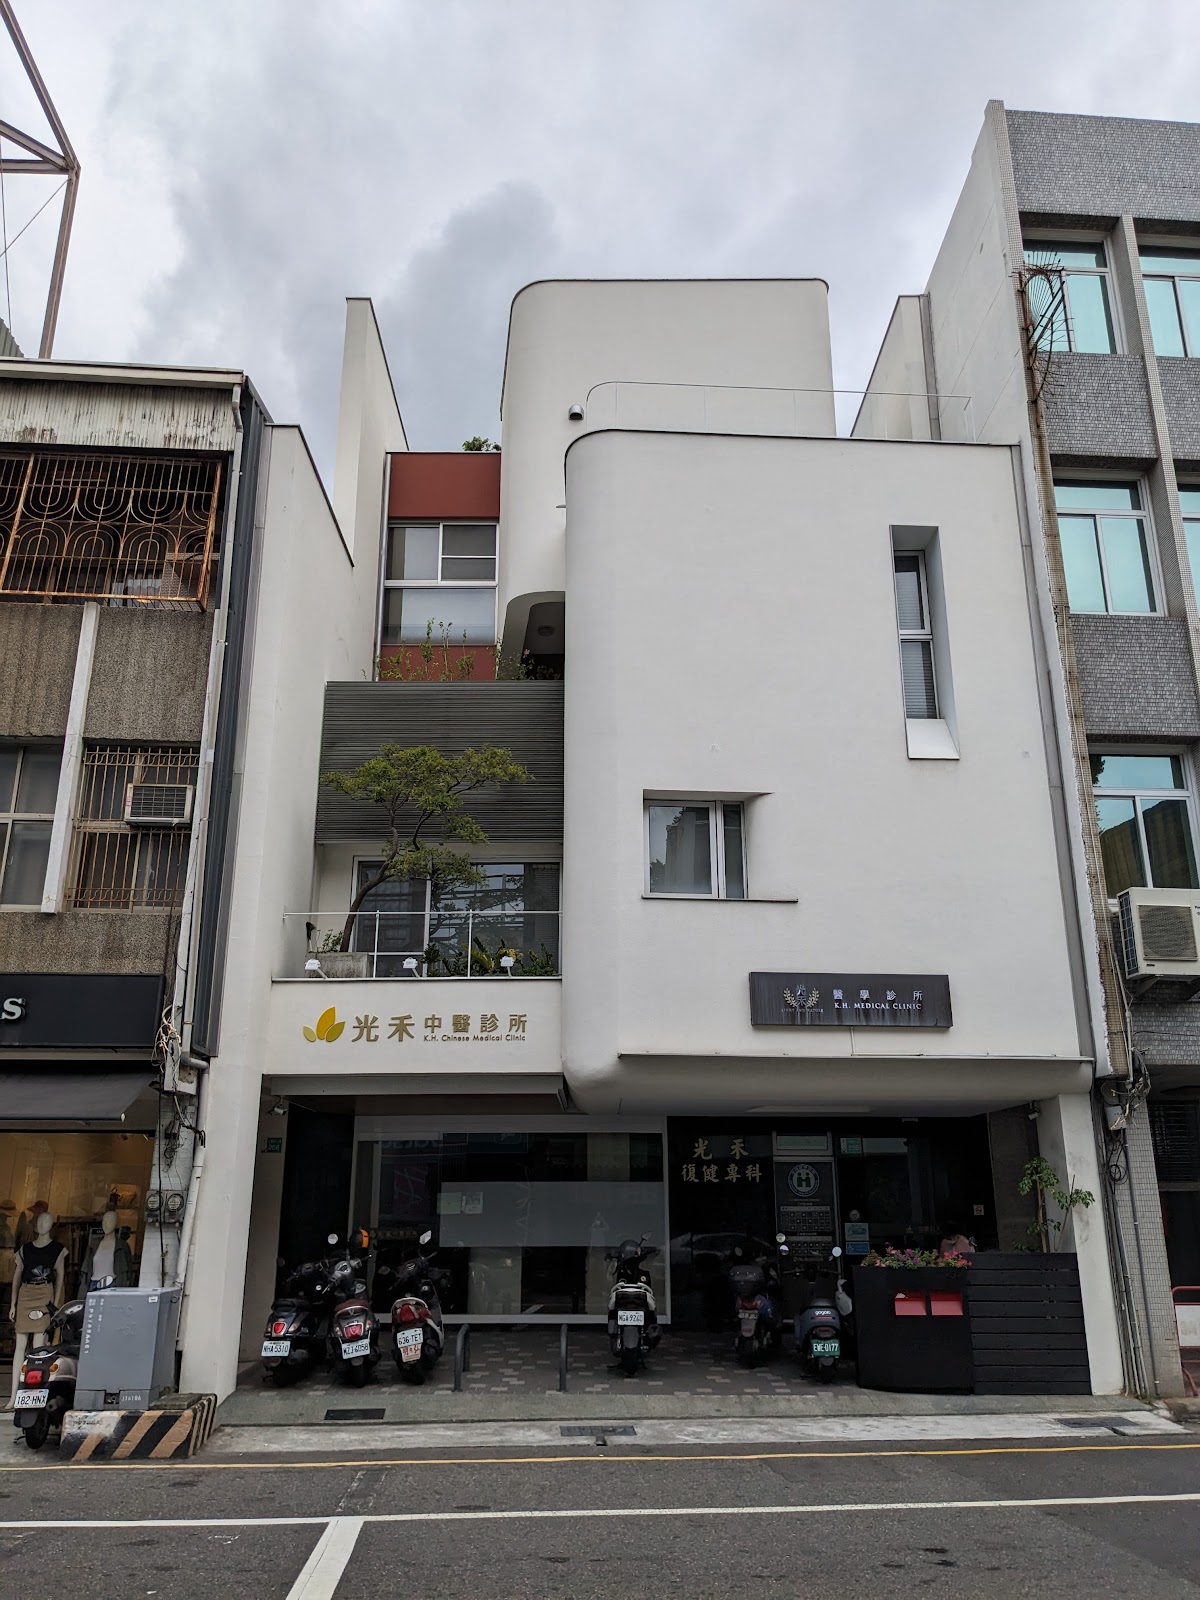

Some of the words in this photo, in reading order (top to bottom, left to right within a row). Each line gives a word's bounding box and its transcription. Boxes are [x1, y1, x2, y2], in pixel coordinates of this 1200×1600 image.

[832, 989, 923, 1001] 醫學診所
[352, 1013, 528, 1042] 光禾中醫診所
[423, 1034, 439, 1042] K.H.
[441, 1034, 470, 1042] Chinese
[472, 1034, 503, 1042] Medical
[505, 1034, 526, 1042] Clinic
[692, 1137, 749, 1160] 光禾
[681, 1163, 763, 1183] 復健專科
[16, 1394, 47, 1406] 182-HNX
